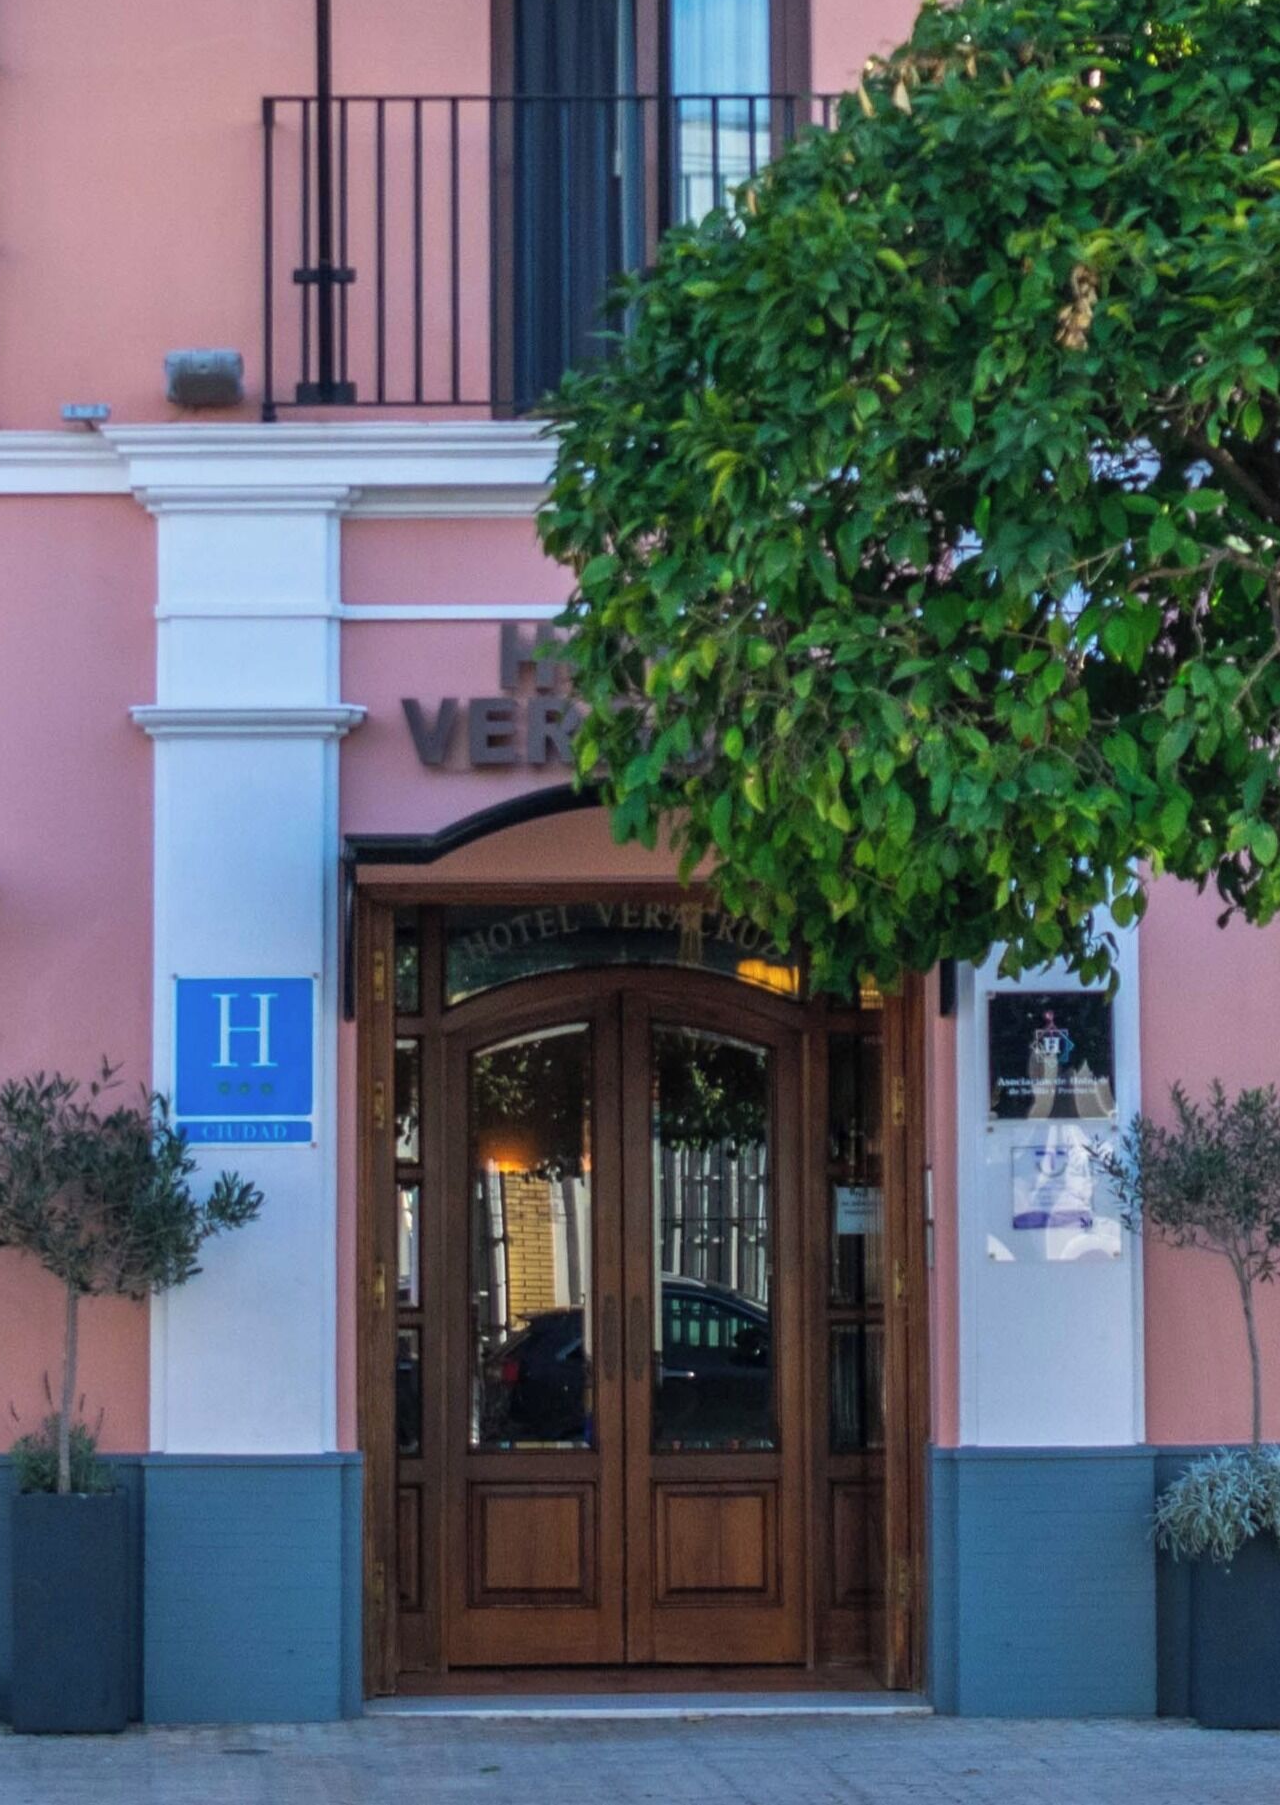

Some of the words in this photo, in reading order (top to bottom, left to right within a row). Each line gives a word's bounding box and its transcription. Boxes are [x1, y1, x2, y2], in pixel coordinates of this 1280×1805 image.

[463, 904, 580, 960] HOTEL
[211, 993, 279, 1068] H
[202, 1124, 288, 1140] CIUDAD
